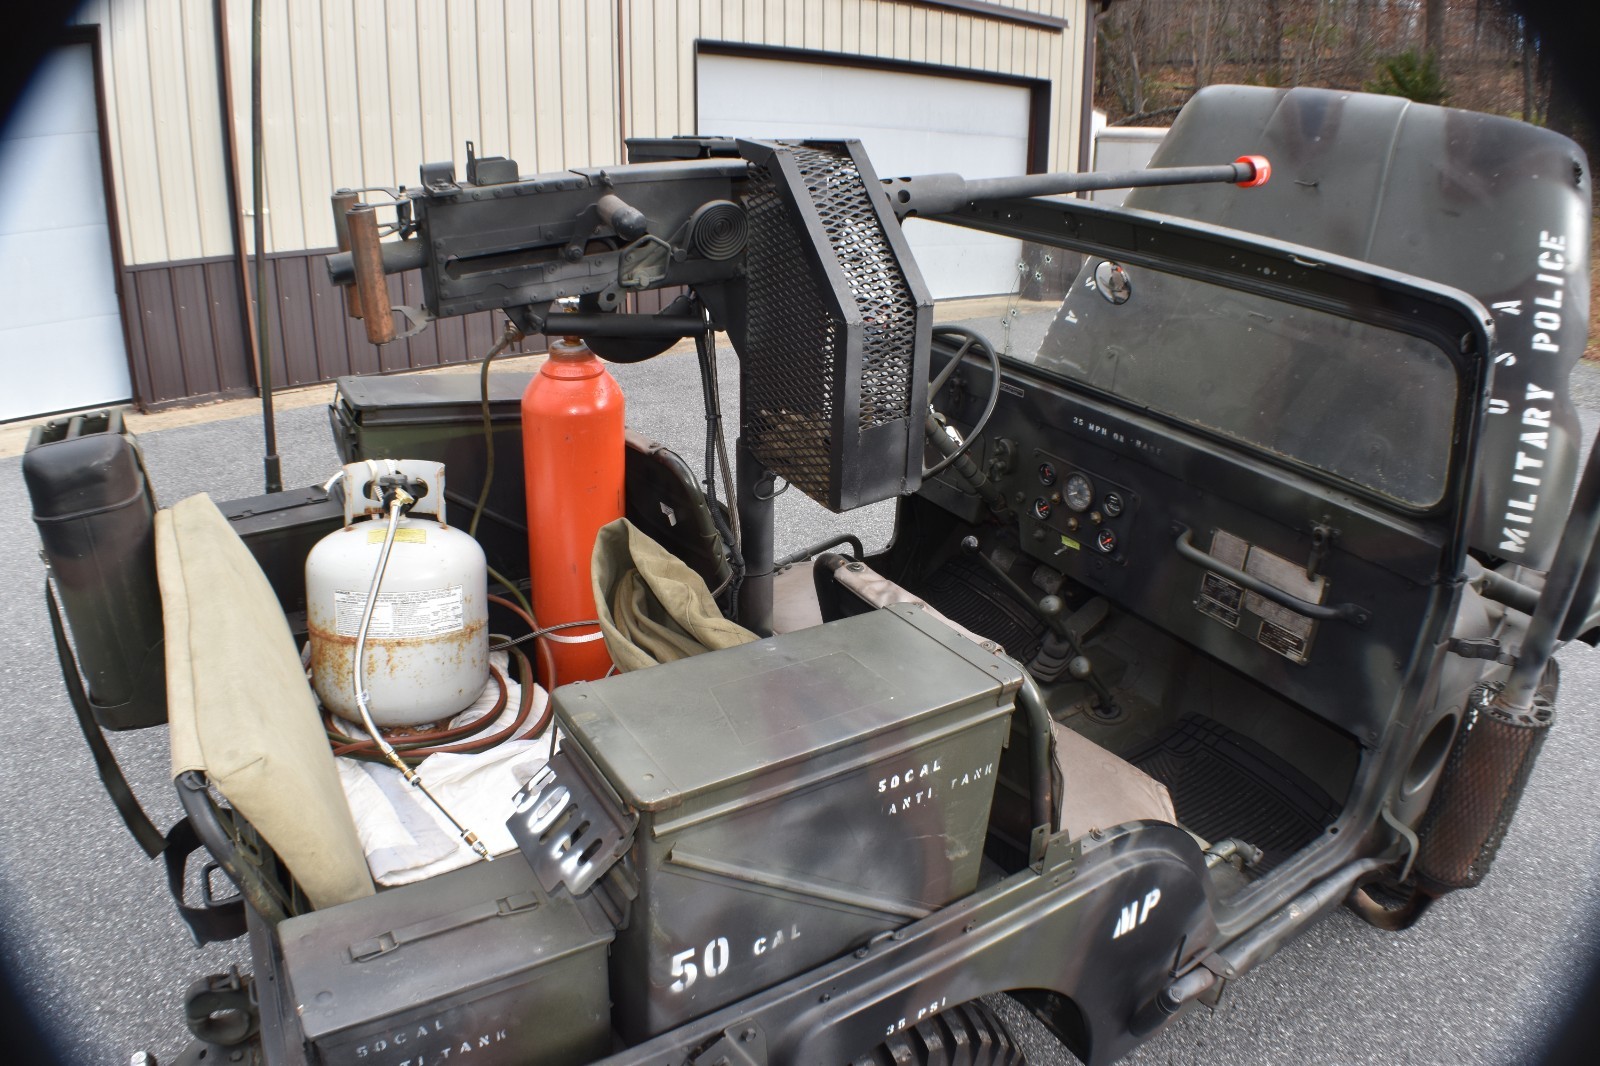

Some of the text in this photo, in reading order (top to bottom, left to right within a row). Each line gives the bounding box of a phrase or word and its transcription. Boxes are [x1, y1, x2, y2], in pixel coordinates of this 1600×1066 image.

[1498, 229, 1567, 554] MILITARY POLICE
[1088, 423, 1107, 436] MPH
[887, 762, 993, 816] ANTI TANK
[1112, 888, 1161, 939] MP
[669, 923, 801, 993] 50 CAL
[917, 996, 947, 1021] PSI
[440, 1028, 507, 1059] TANK
